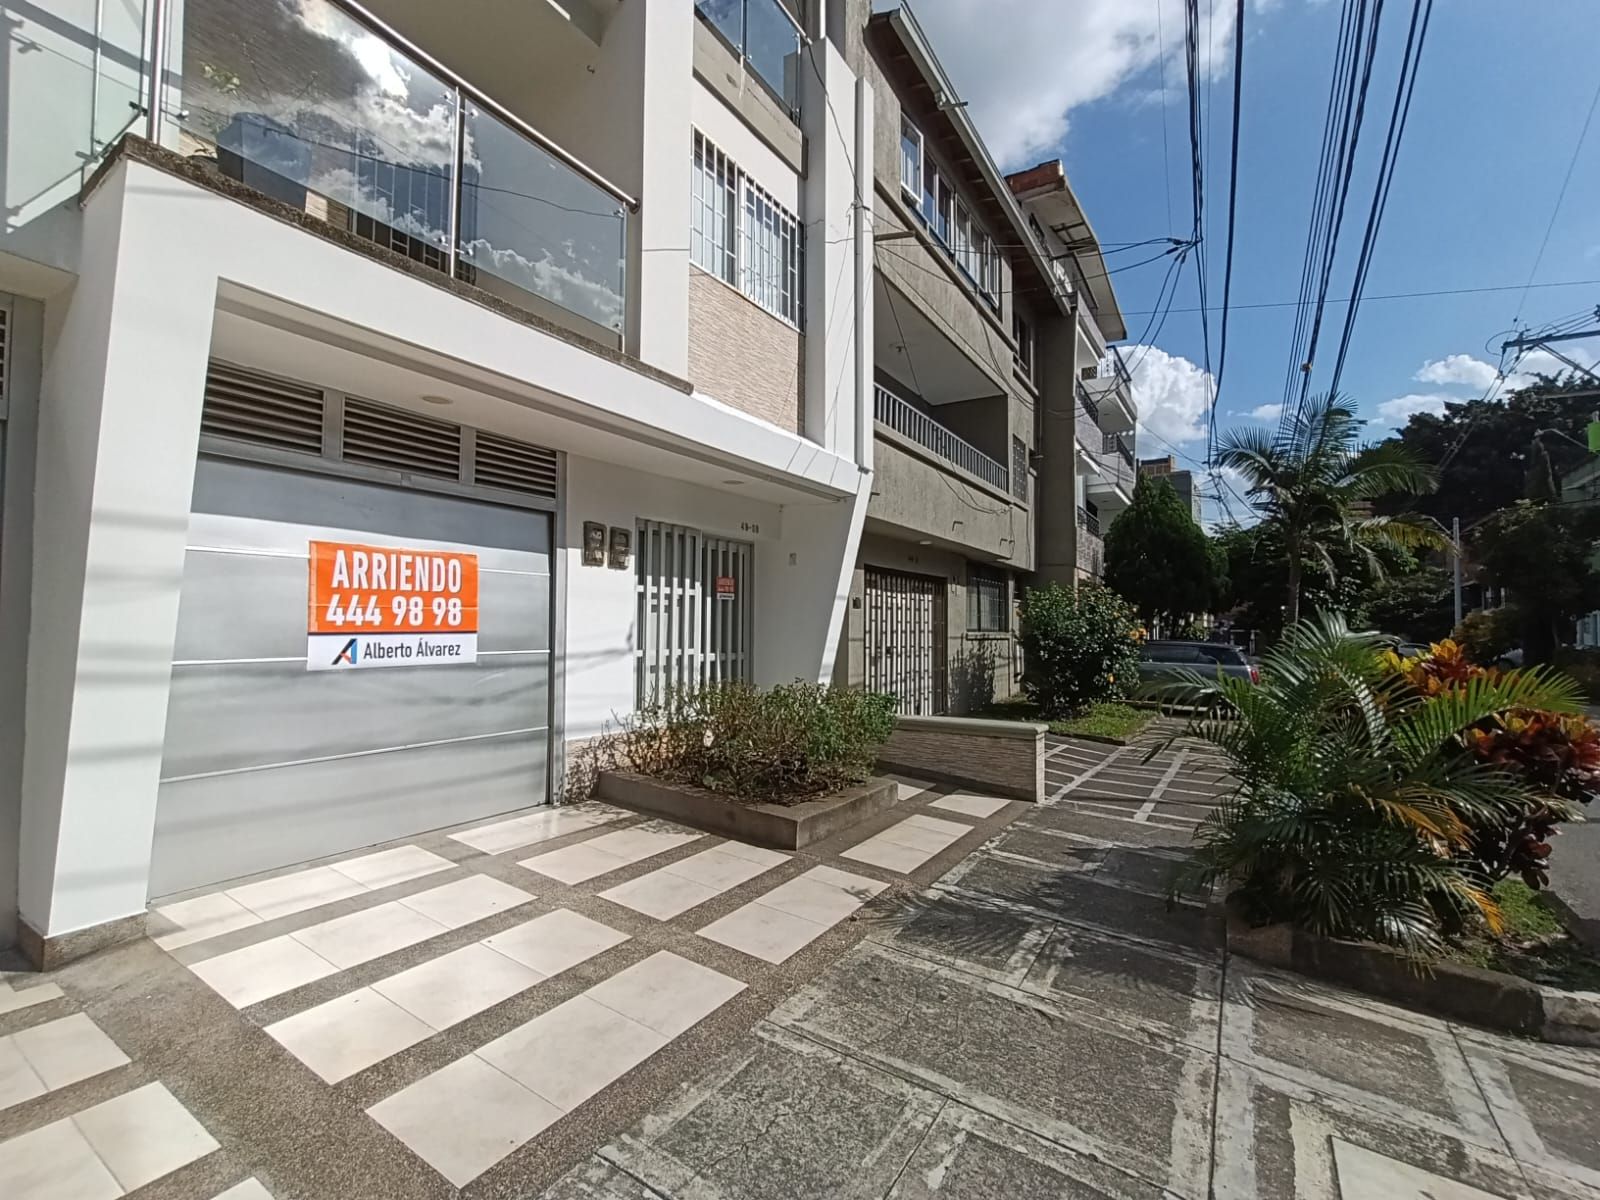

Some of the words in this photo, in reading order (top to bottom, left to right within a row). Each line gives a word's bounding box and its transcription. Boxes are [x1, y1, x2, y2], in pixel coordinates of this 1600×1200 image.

[331, 549, 462, 593] ARRIENDO
[325, 594, 382, 626] 444
[391, 595, 424, 626] 98
[432, 597, 462, 627] 98
[363, 642, 413, 660] Alberto
[416, 638, 461, 658] Álvarez
